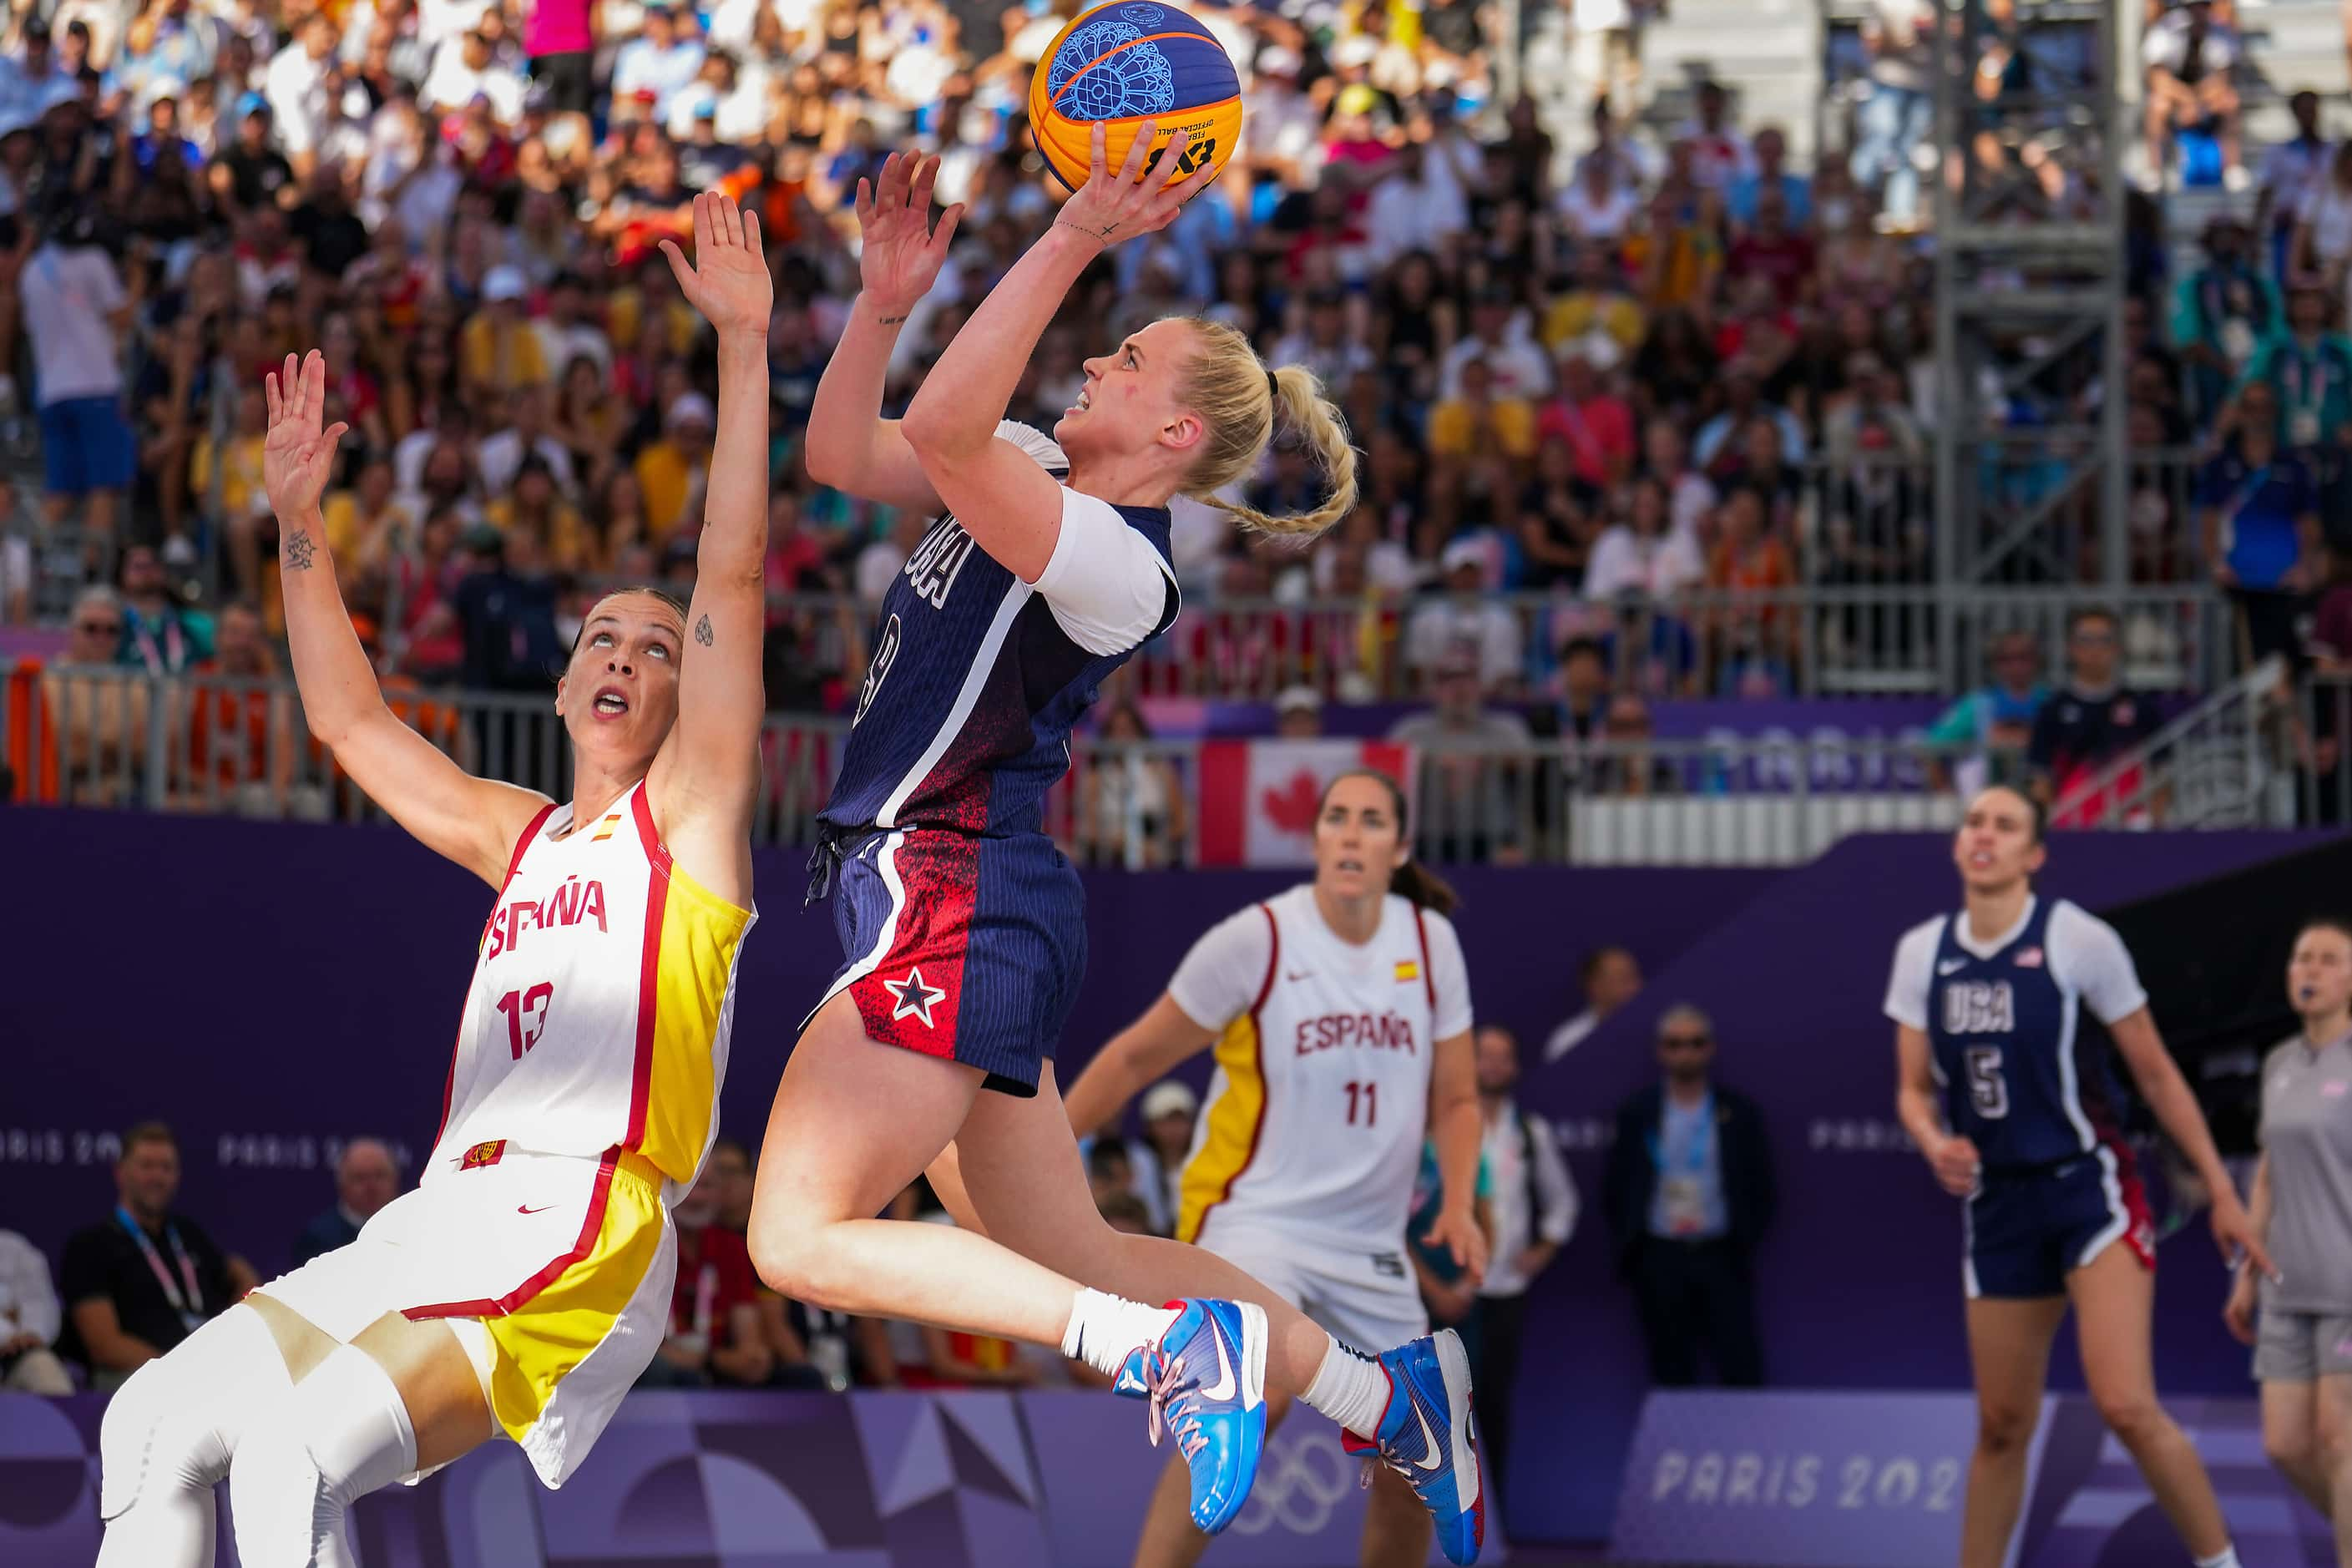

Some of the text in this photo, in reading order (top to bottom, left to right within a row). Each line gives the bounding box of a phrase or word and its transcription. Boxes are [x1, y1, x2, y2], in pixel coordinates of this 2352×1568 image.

[904, 512, 975, 610] USA
[488, 874, 609, 960] SPAÑA
[497, 981, 554, 1061] 13
[1295, 1009, 1416, 1058] ESPAÑA
[1942, 980, 2014, 1034] USA
[1343, 1081, 1378, 1127] 11
[1963, 1045, 2009, 1119] 5
[0, 1129, 64, 1165] RIS
[1651, 1450, 1963, 1514] PARIS 202
